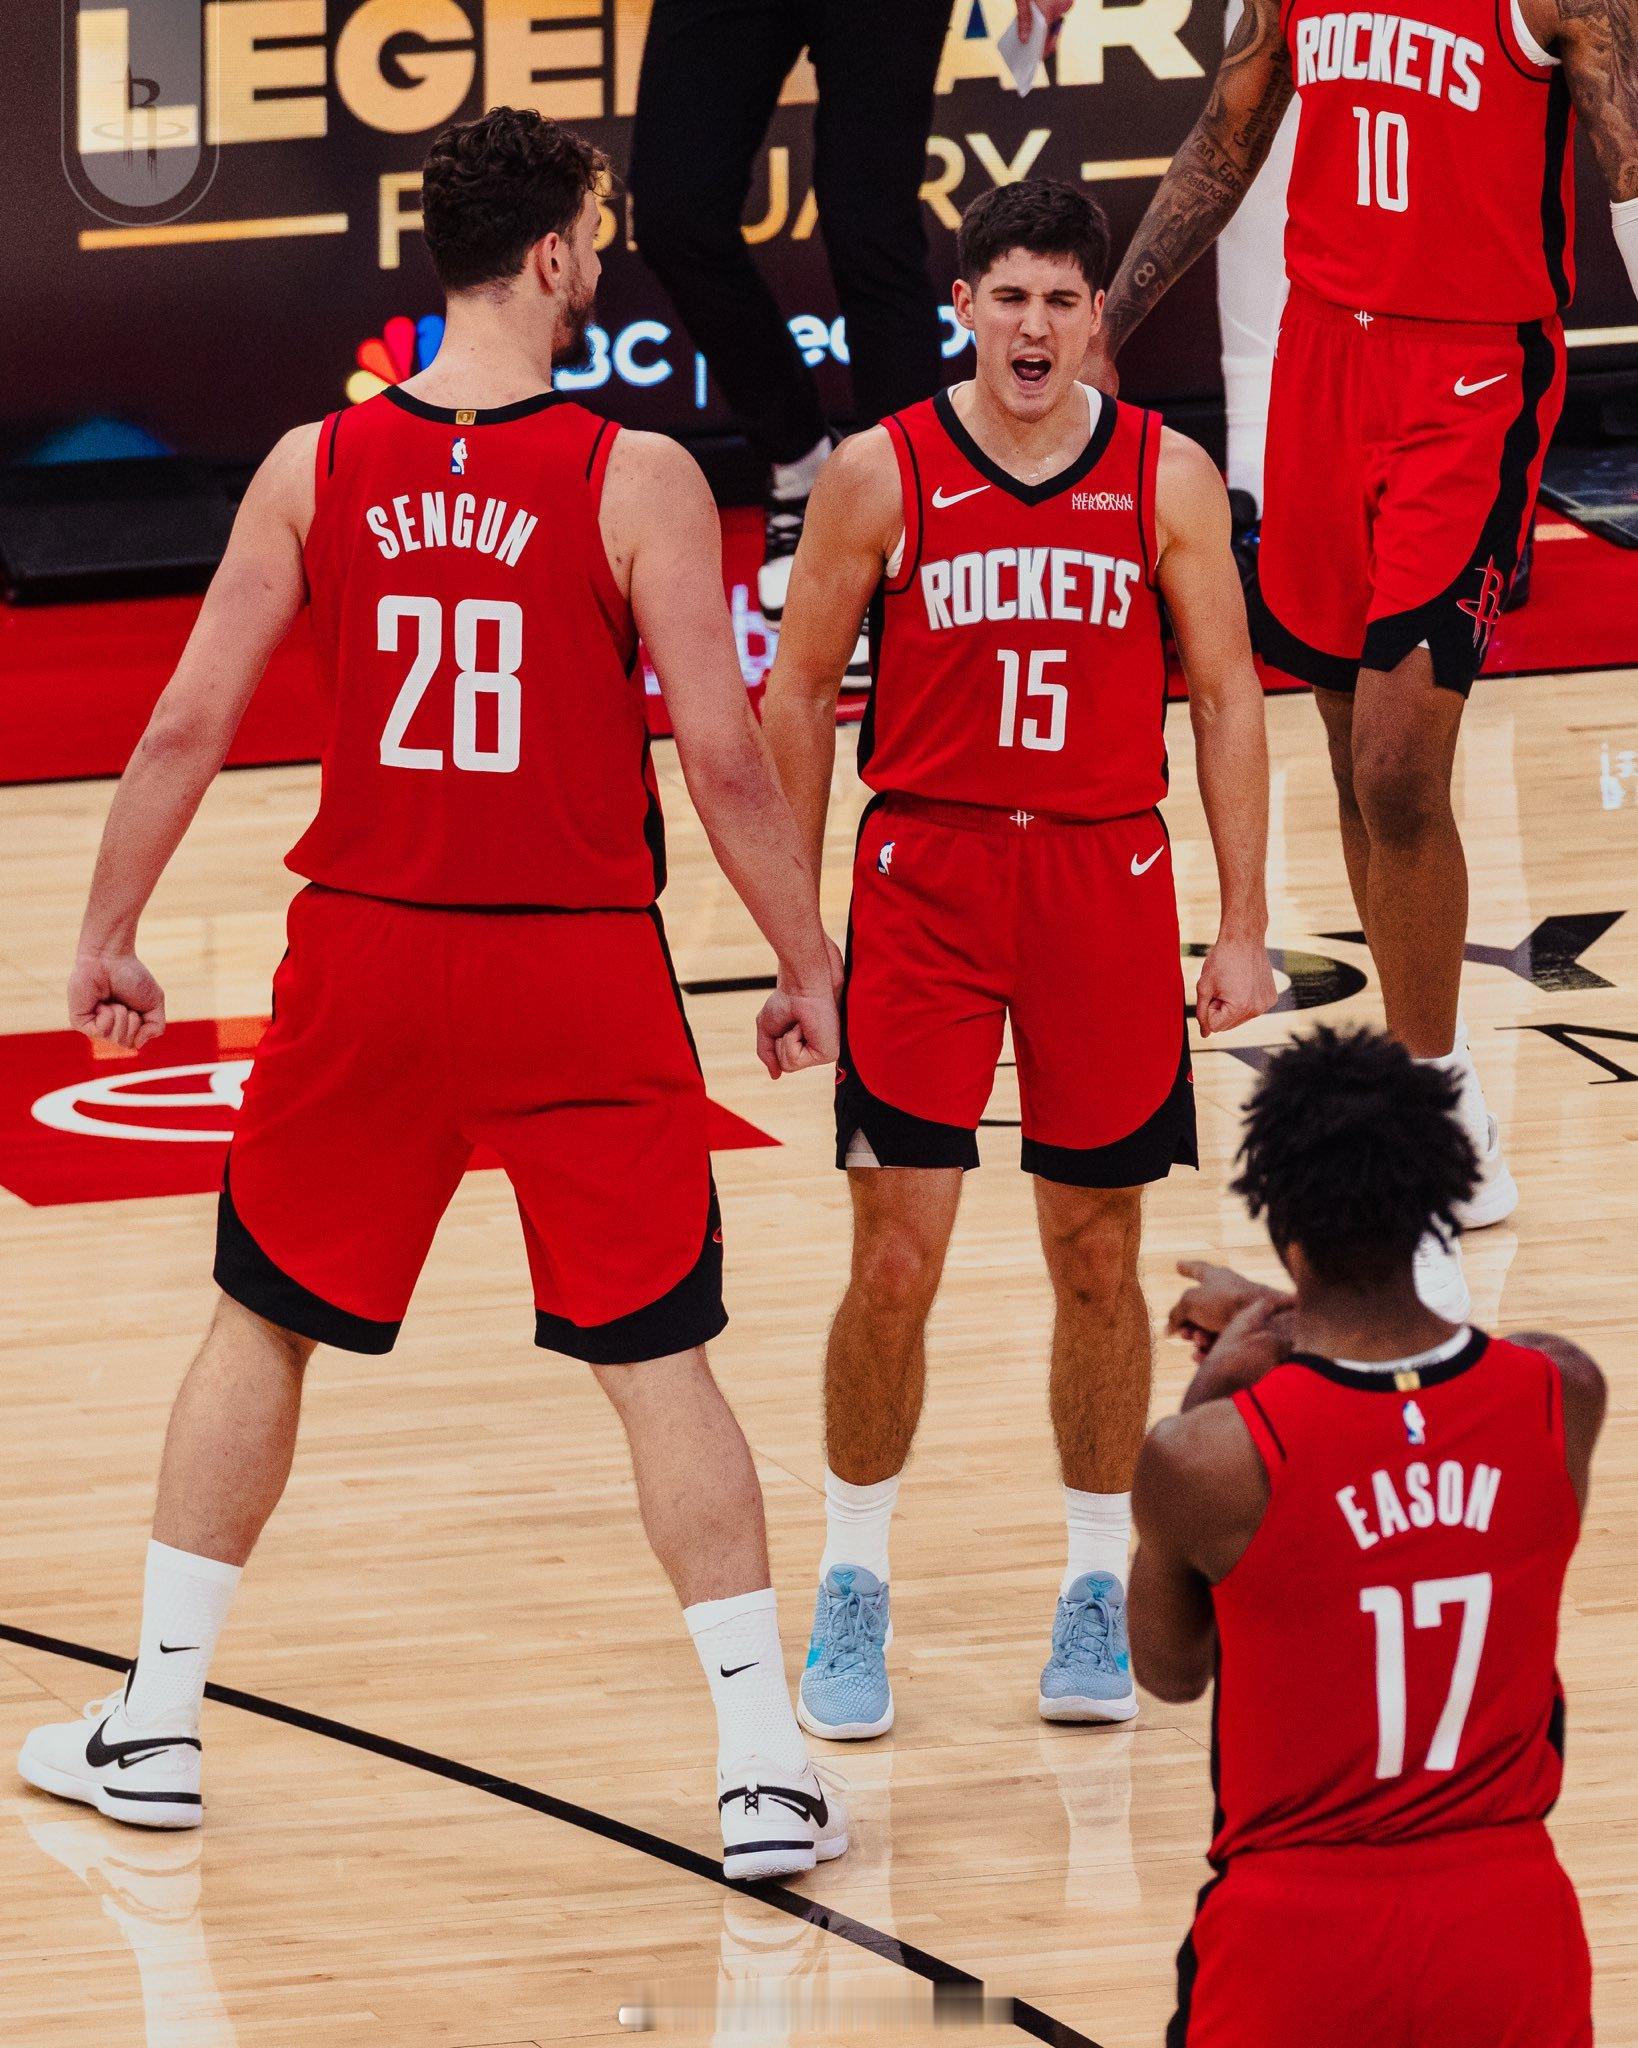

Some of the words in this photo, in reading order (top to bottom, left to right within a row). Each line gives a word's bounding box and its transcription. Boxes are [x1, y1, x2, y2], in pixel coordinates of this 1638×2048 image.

[1297, 12, 1485, 112] ROCKETS
[1353, 106, 1409, 213] 10
[366, 491, 539, 568] SENGUN
[1071, 491, 1133, 504] MEMORIAL
[1071, 500, 1133, 511] HERMANN
[920, 547, 1141, 631] ROCKETS
[376, 594, 523, 774] 28
[996, 648, 1069, 752] 15
[1335, 1460, 1502, 1550] EASON
[1359, 1571, 1493, 1780] 17
